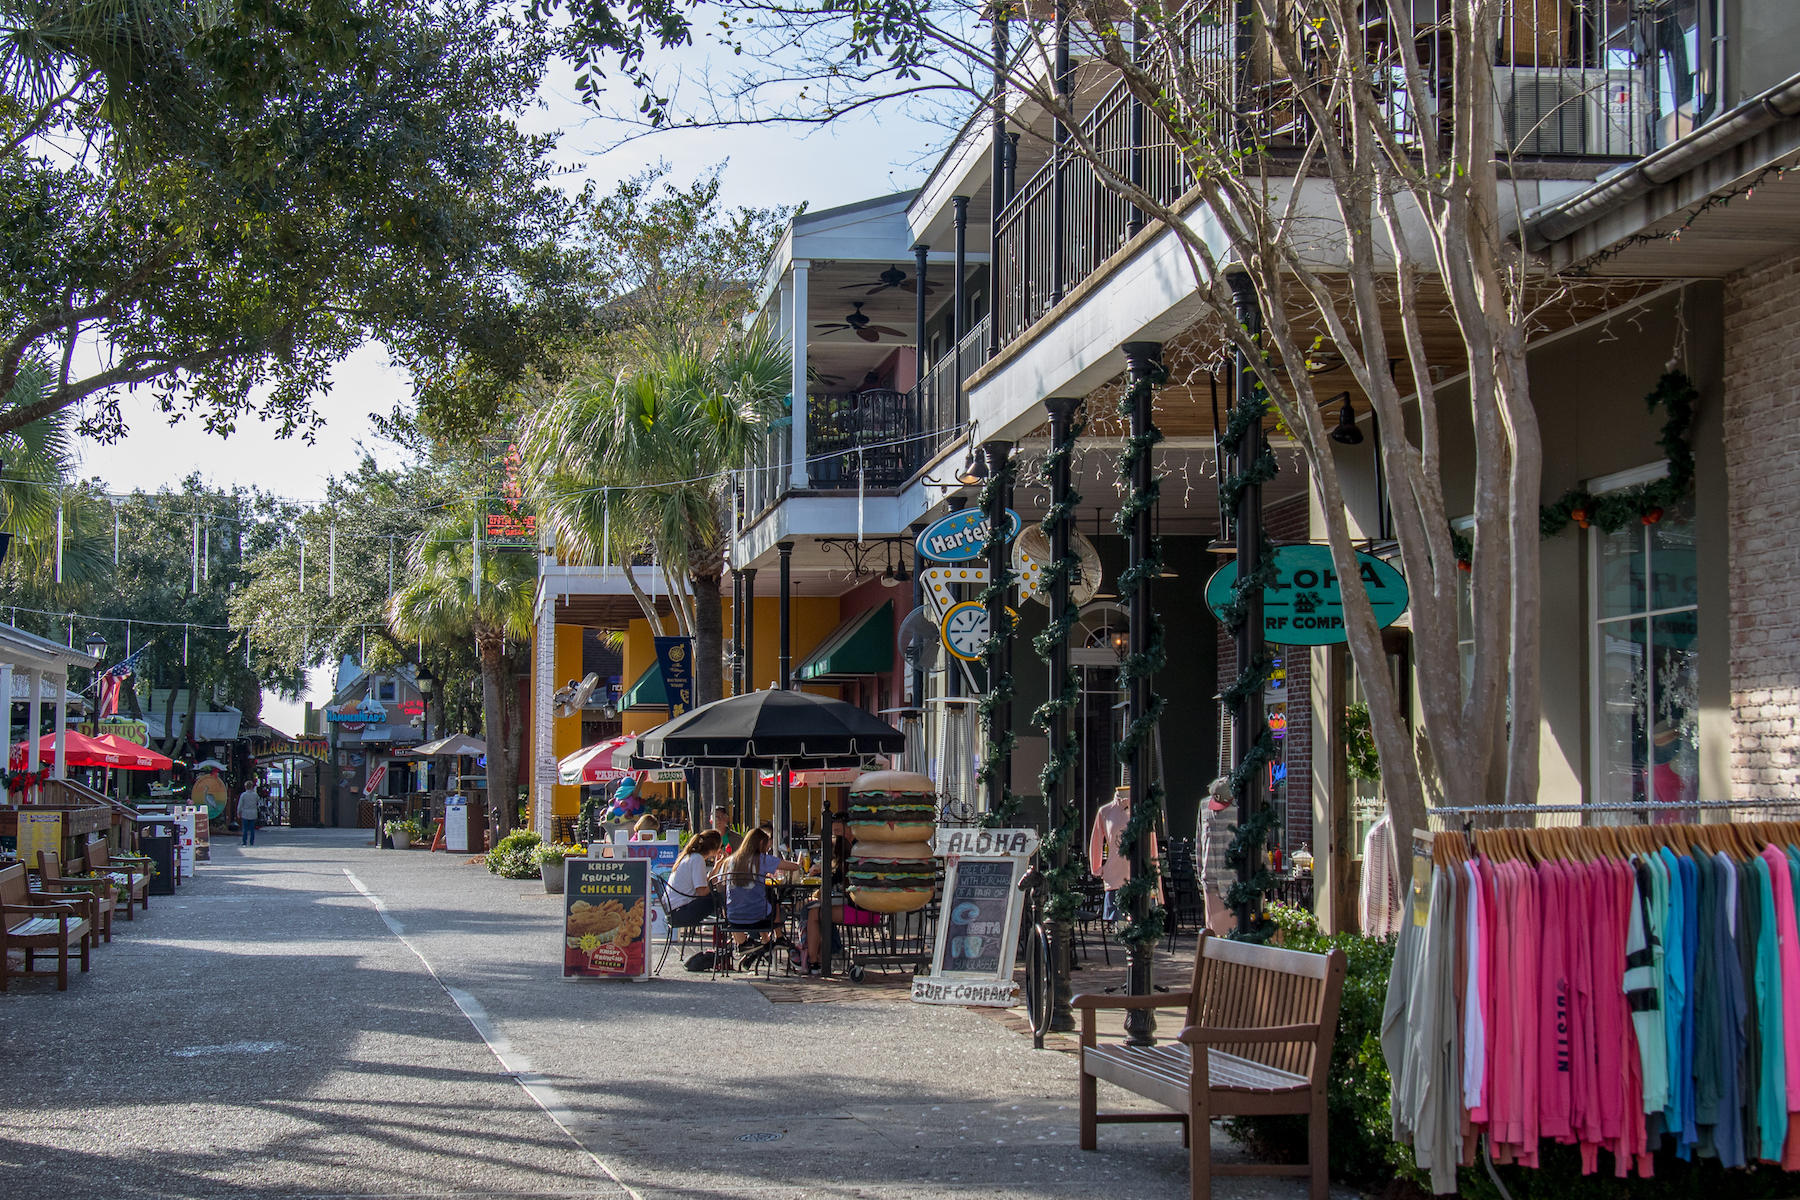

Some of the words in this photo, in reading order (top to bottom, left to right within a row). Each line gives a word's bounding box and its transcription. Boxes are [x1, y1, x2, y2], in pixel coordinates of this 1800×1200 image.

[293, 740, 329, 764] DOOR
[594, 770, 637, 781] TABASCO
[950, 831, 1028, 854] ALOHA
[588, 863, 624, 871] KRISPY
[960, 865, 978, 875] FREE
[980, 864, 998, 875] GIFT
[581, 873, 630, 883] KRUNCHY
[961, 876, 979, 885] WITH
[580, 885, 632, 894] CHICKEN
[974, 888, 991, 897] PAIR
[914, 983, 953, 1000] SURF
[954, 984, 1014, 1001] COMPANY
